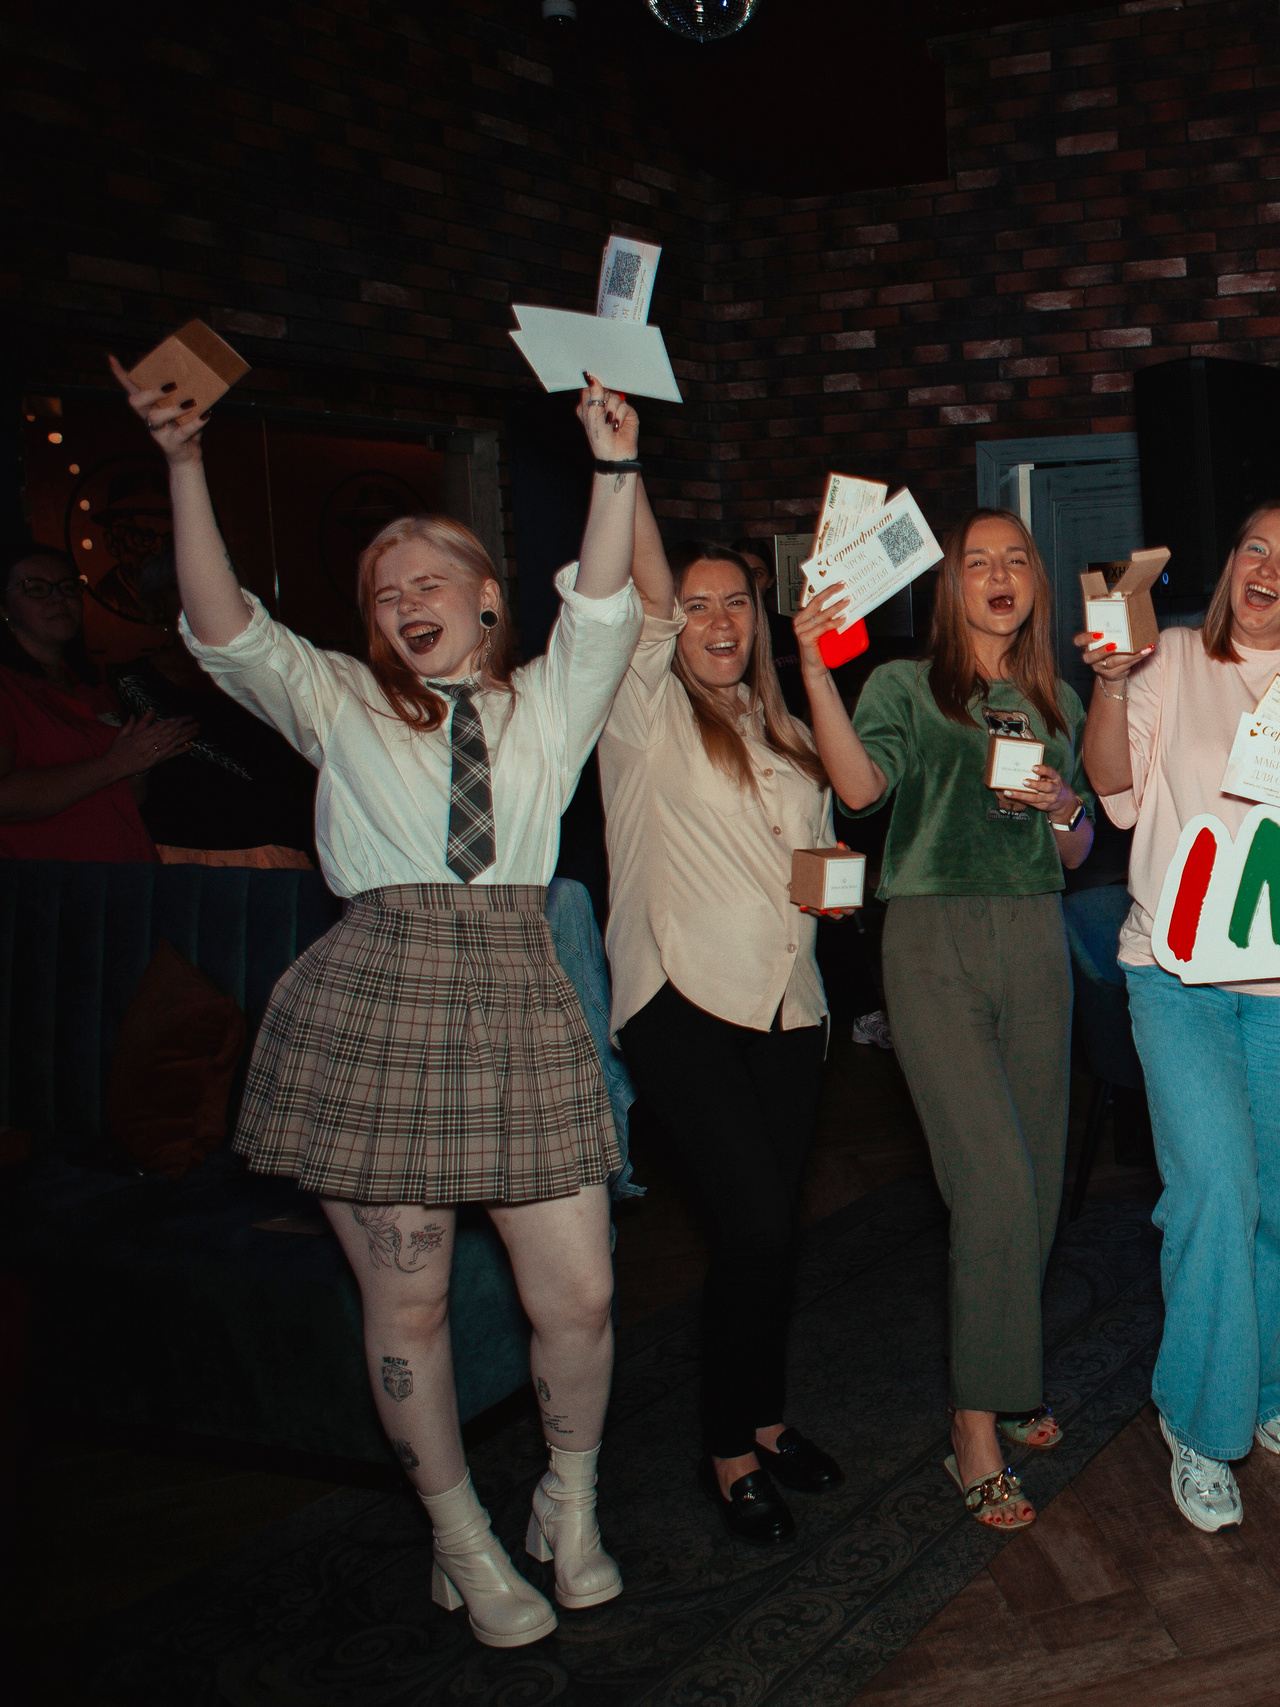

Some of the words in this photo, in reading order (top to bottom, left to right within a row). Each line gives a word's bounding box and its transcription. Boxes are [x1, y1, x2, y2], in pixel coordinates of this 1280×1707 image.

[825, 512, 893, 567] Сертификат
[844, 550, 867, 571] УРОК
[1250, 769, 1274, 784] ДЛЯ
